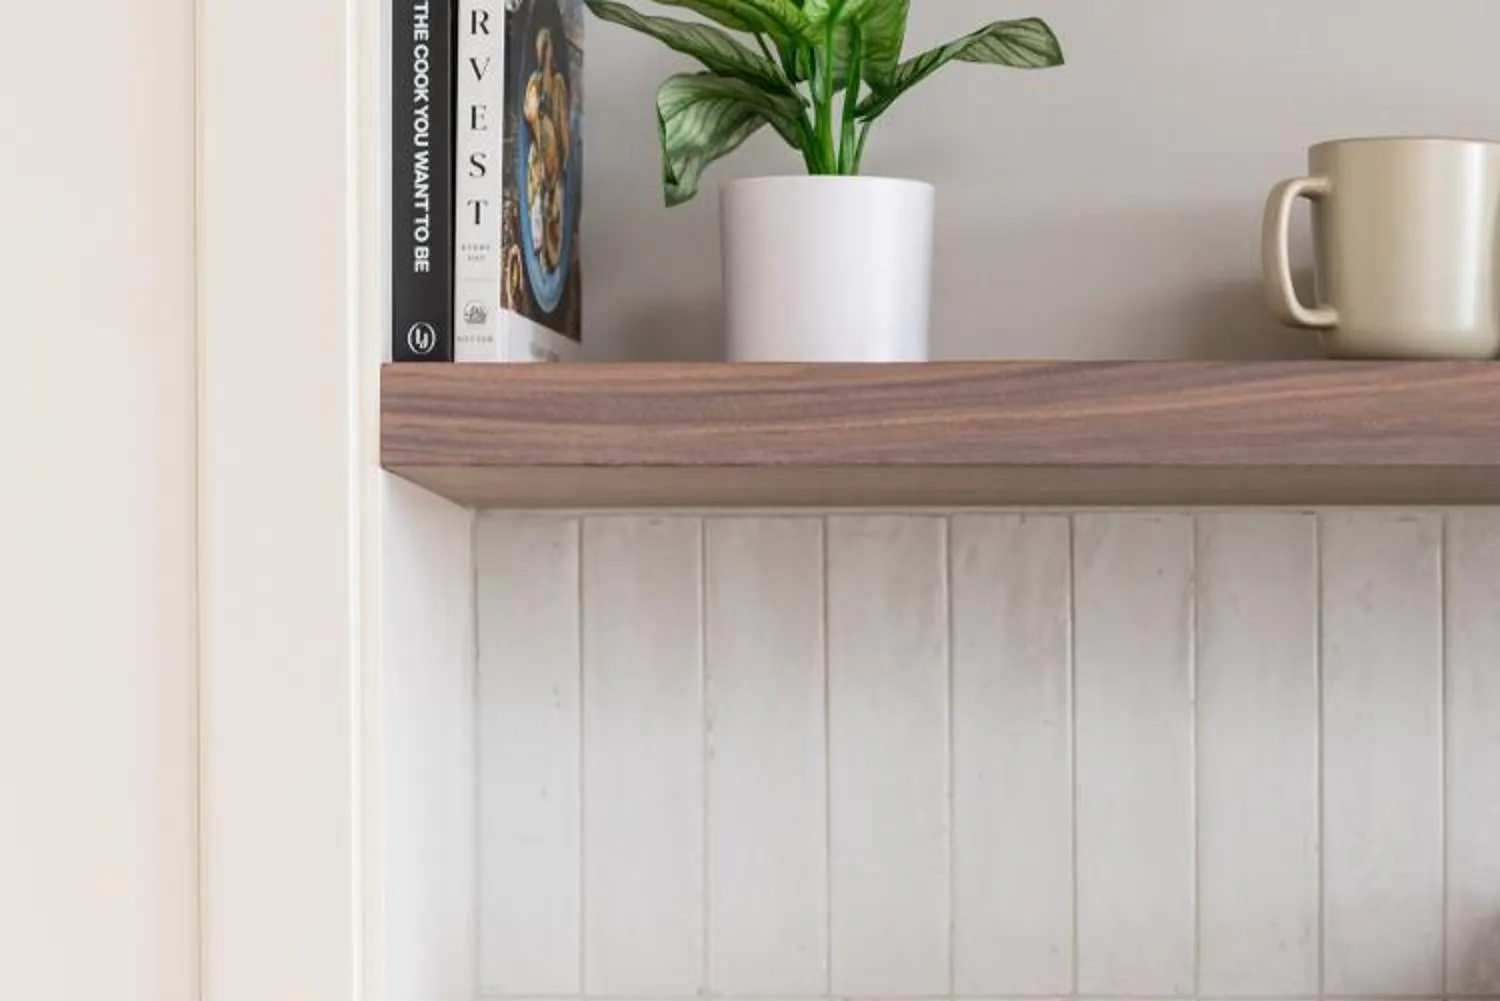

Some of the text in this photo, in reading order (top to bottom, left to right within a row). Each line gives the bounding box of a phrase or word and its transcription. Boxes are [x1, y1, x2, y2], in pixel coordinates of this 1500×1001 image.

[413, 0, 430, 273] THE COOK YOU WANT TO BE
